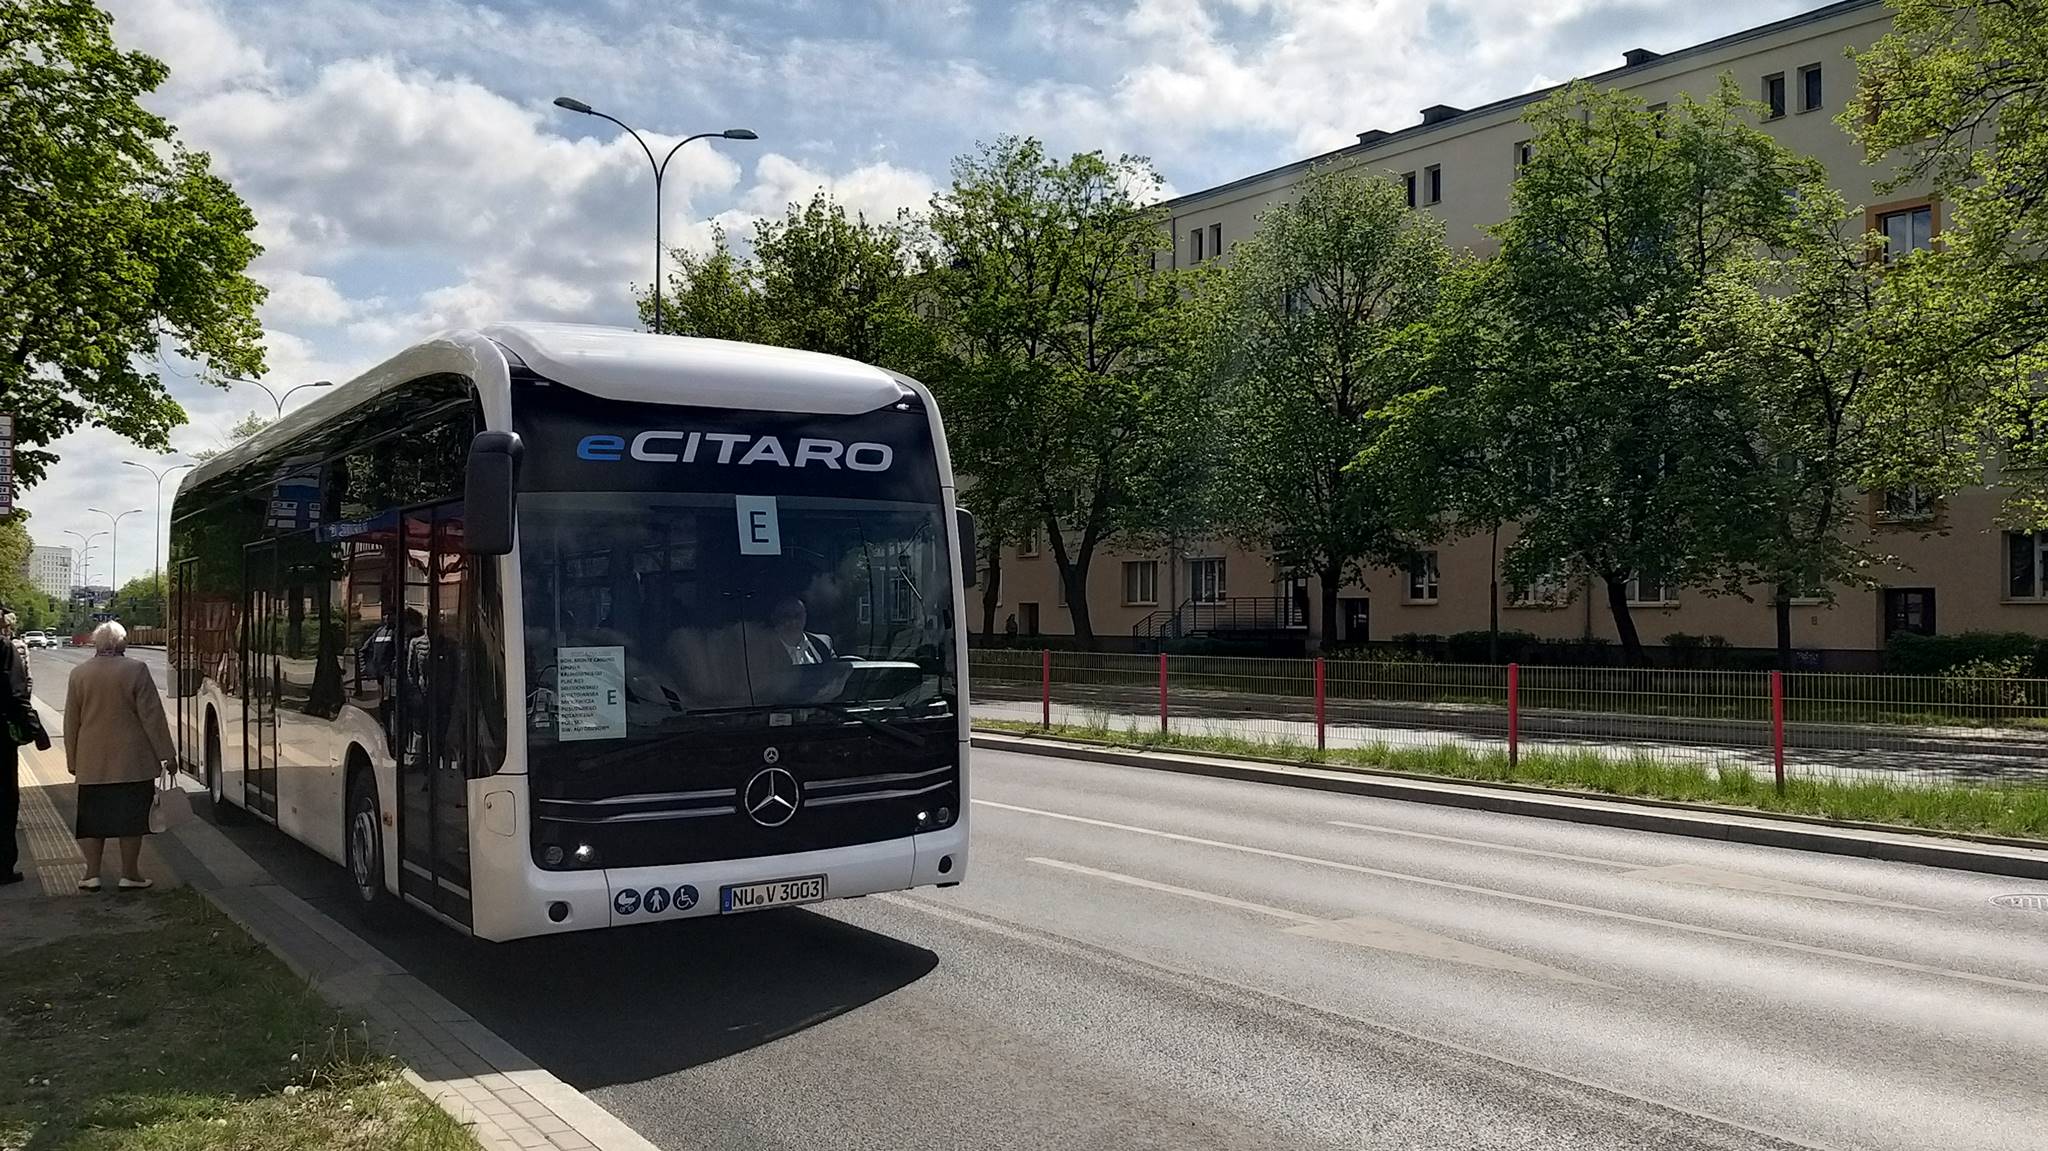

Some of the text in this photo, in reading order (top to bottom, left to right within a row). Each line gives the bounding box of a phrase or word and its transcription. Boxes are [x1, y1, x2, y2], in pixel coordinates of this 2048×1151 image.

[577, 431, 893, 472] eCITARO
[749, 510, 770, 544] E
[607, 689, 617, 705] E
[733, 887, 755, 907] NU
[766, 885, 776, 902] V
[780, 880, 820, 901] 3003
